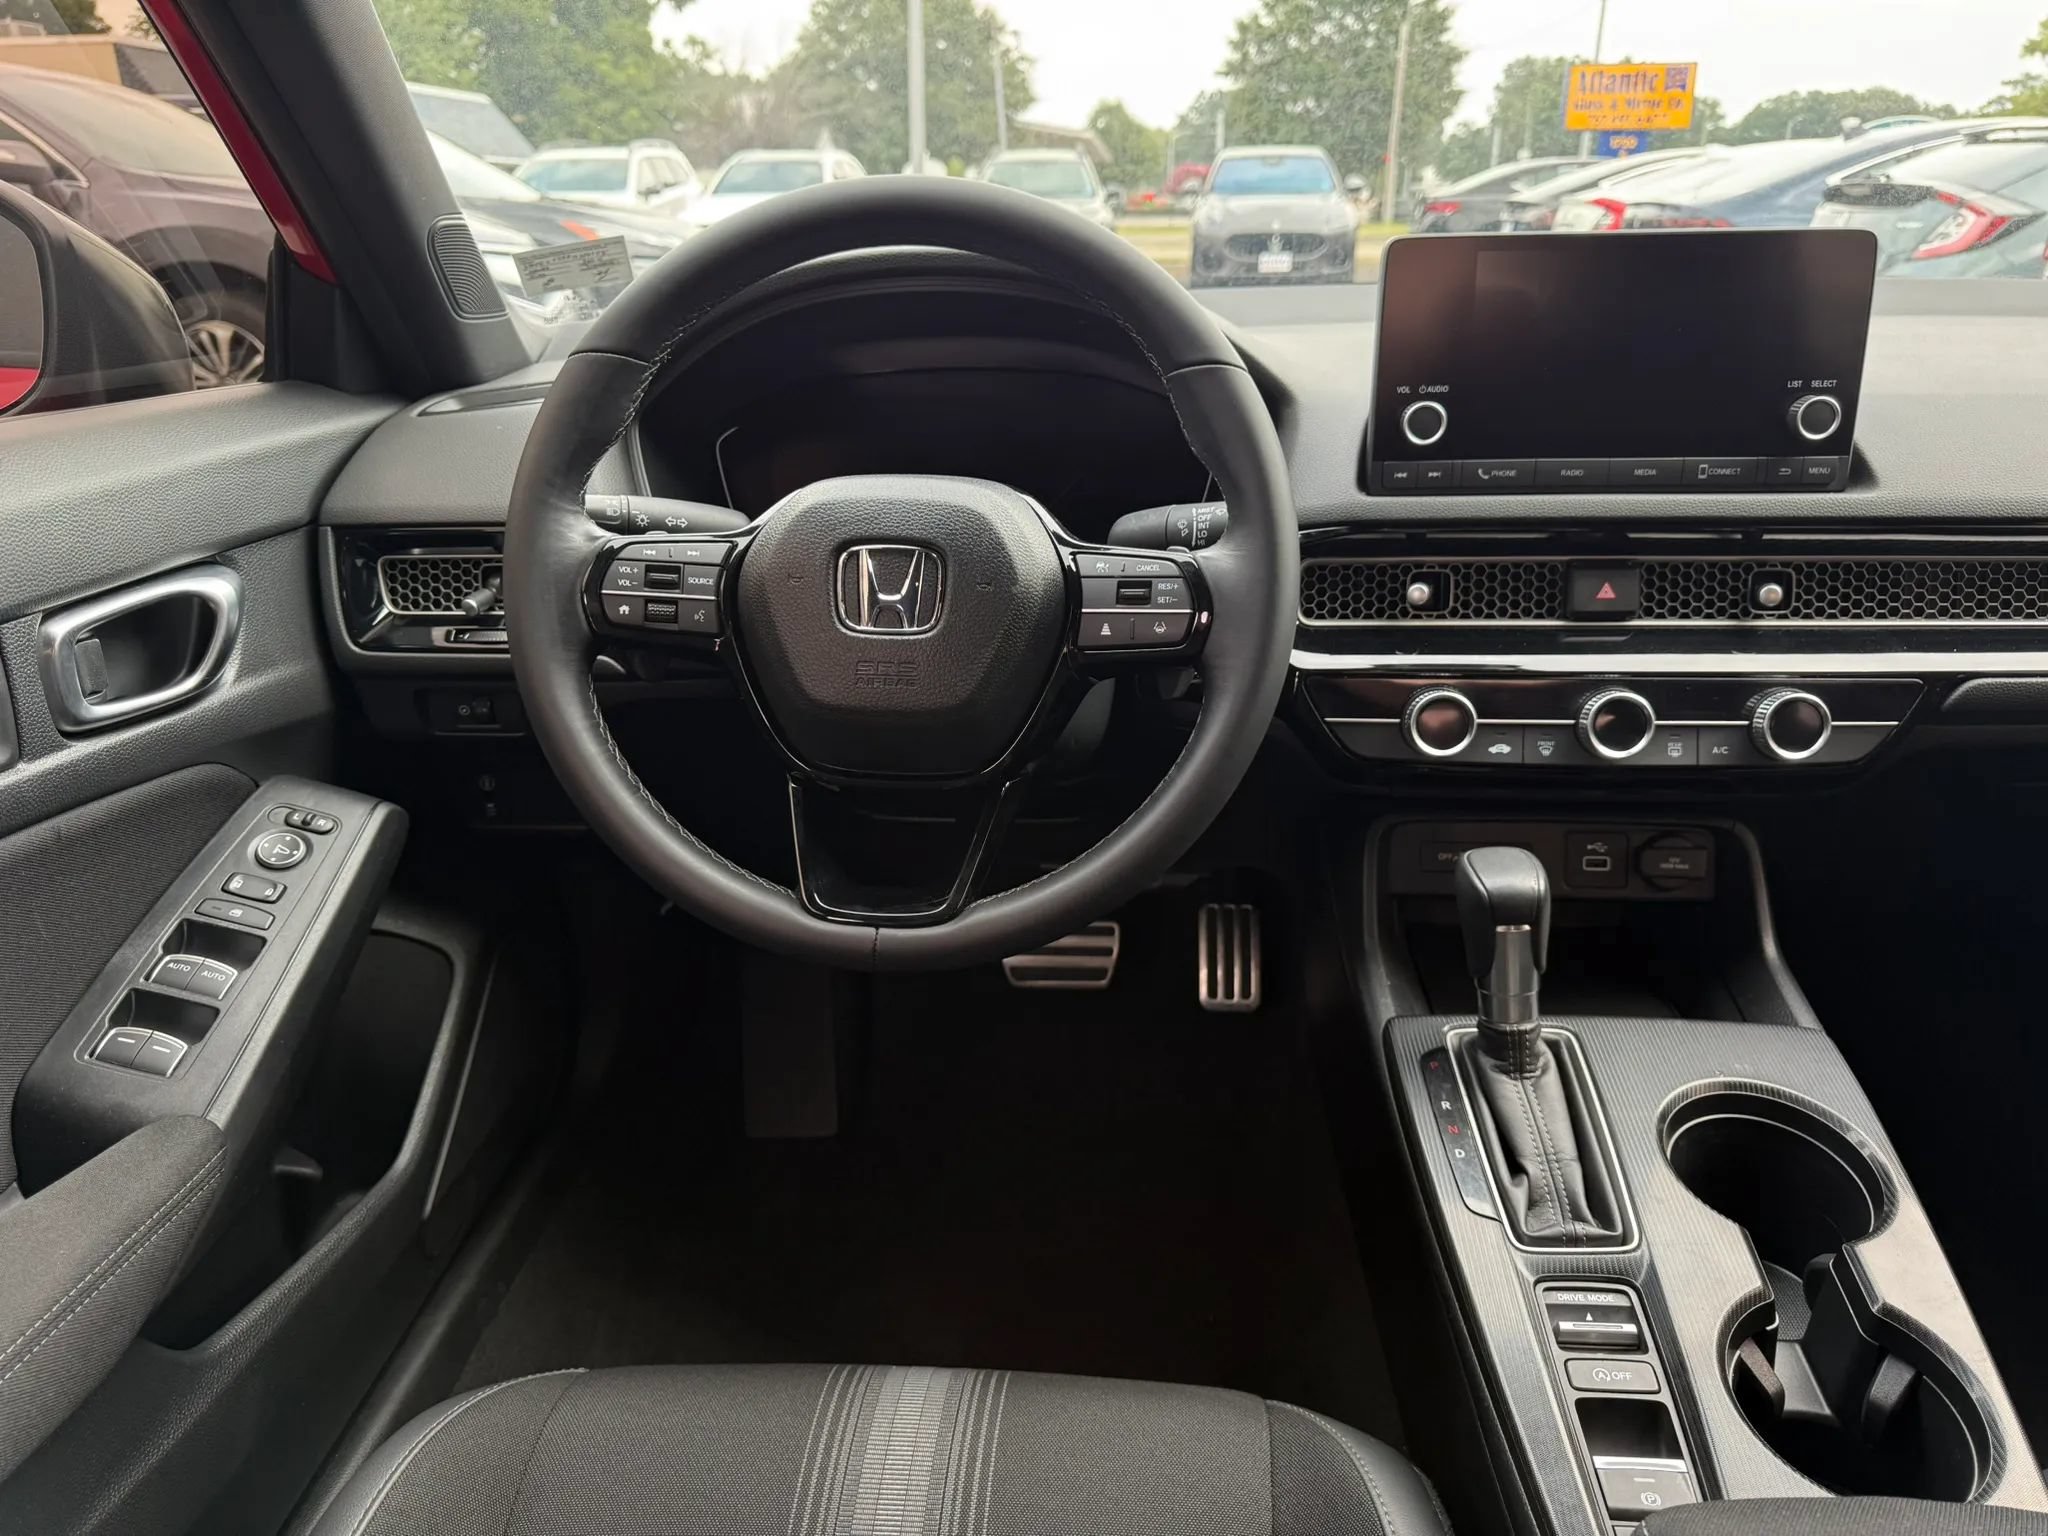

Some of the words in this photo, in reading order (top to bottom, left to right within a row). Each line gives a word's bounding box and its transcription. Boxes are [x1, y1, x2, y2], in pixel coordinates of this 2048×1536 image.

[1787, 380, 1803, 388] LIST
[1811, 380, 1837, 388] SELECT
[1396, 386, 1411, 394] VOL
[1427, 385, 1449, 393] AUDIO
[1560, 469, 1584, 477] RADIO
[1634, 468, 1657, 476] MEDIA
[1708, 467, 1742, 476] CONNECT
[1808, 467, 1831, 475] MENU
[1197, 513, 1212, 521] OFF
[1197, 521, 1210, 529] INT
[1197, 530, 1208, 538] LO
[1136, 564, 1160, 572] CANCEL
[687, 576, 714, 586] SOURCE
[1712, 746, 1728, 755] A/C
[167, 961, 191, 973] AUTO
[201, 969, 226, 982] AUTO
[1440, 1100, 1452, 1110] R
[1447, 1124, 1459, 1134] N
[1454, 1148, 1465, 1158] D
[1557, 1293, 1585, 1302] DRIVE
[1587, 1294, 1615, 1302] MODE
[1611, 1371, 1633, 1380] OFF
